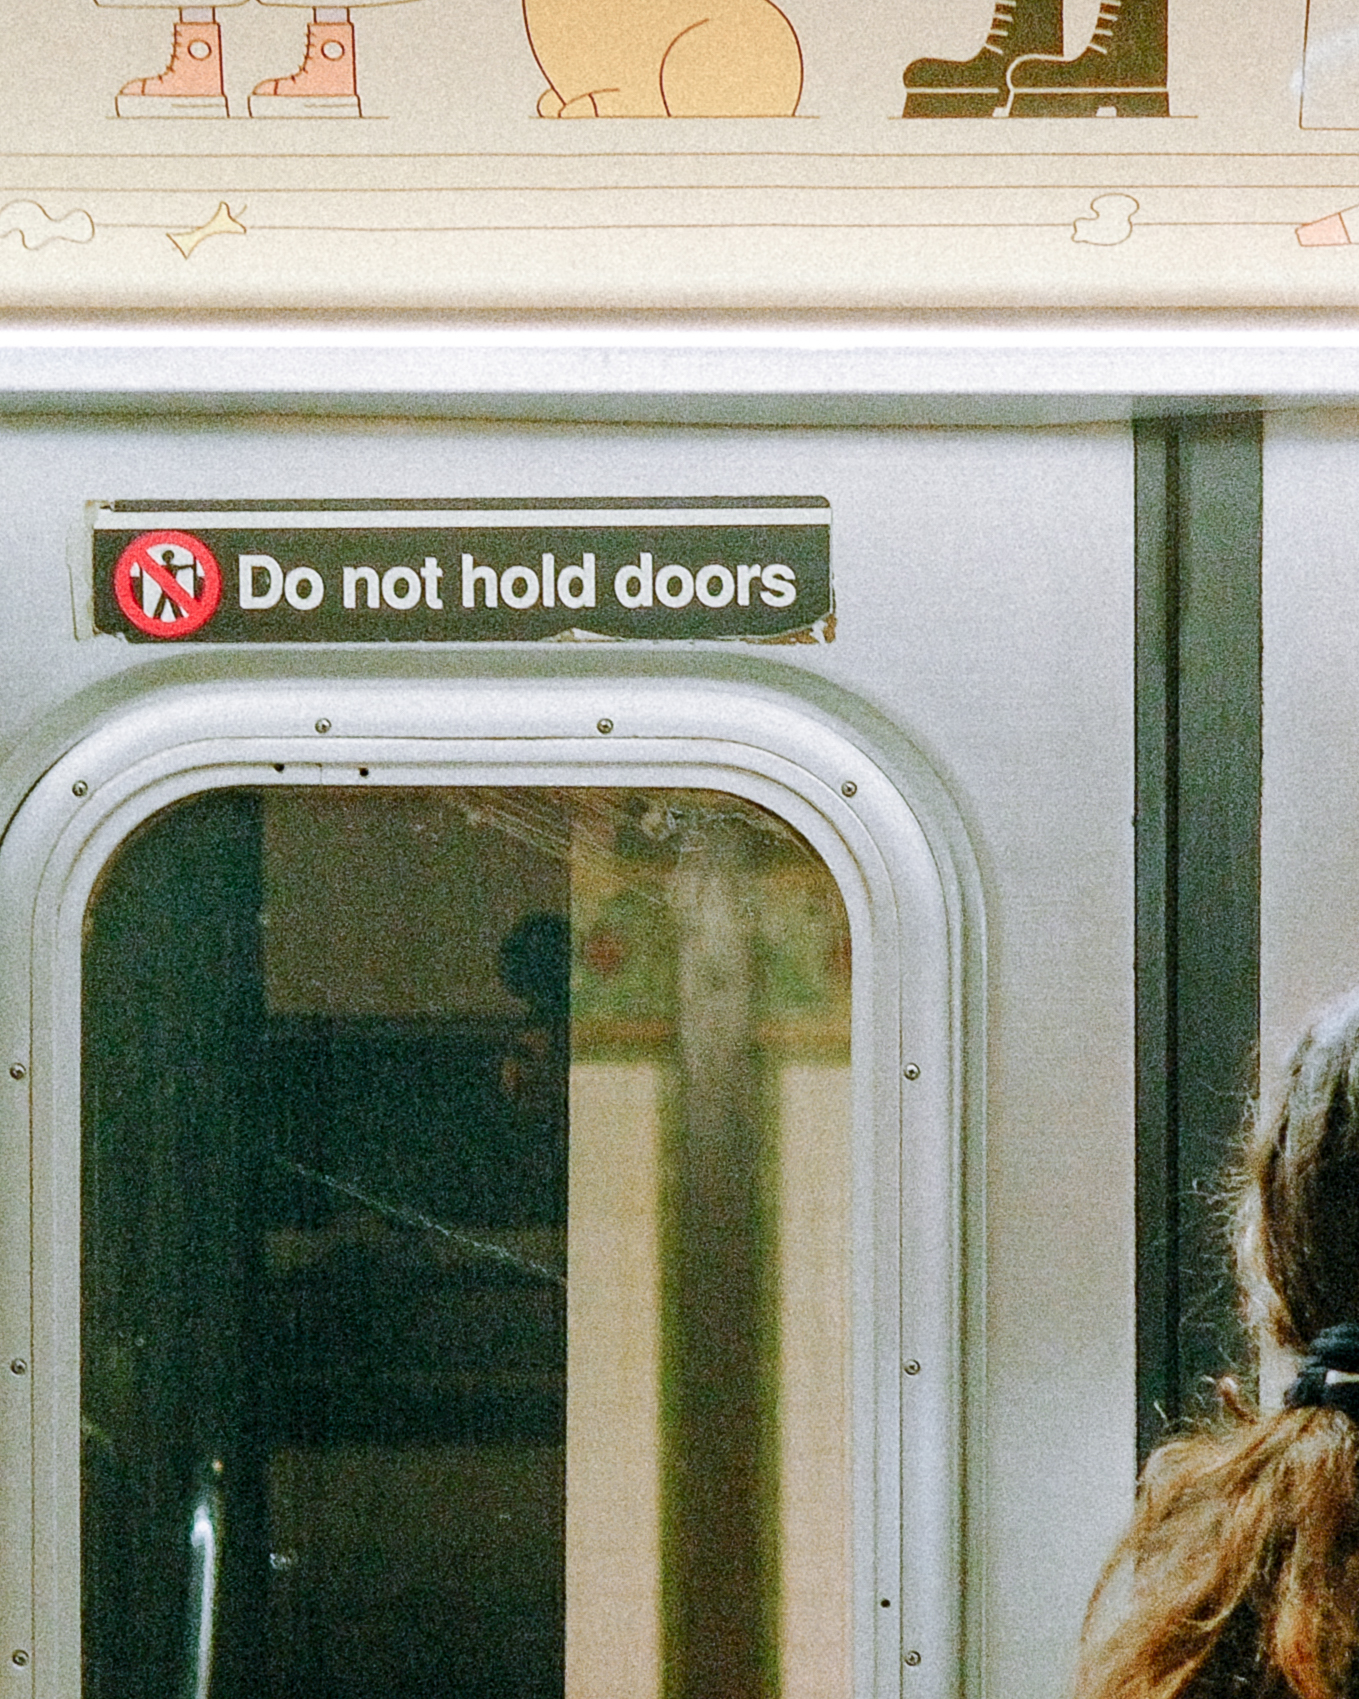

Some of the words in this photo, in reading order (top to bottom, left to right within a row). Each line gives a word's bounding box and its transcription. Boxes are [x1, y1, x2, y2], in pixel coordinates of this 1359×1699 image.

[240, 553, 324, 610] Do
[343, 556, 443, 610] not
[462, 552, 595, 609] hold
[614, 552, 796, 609] doors
